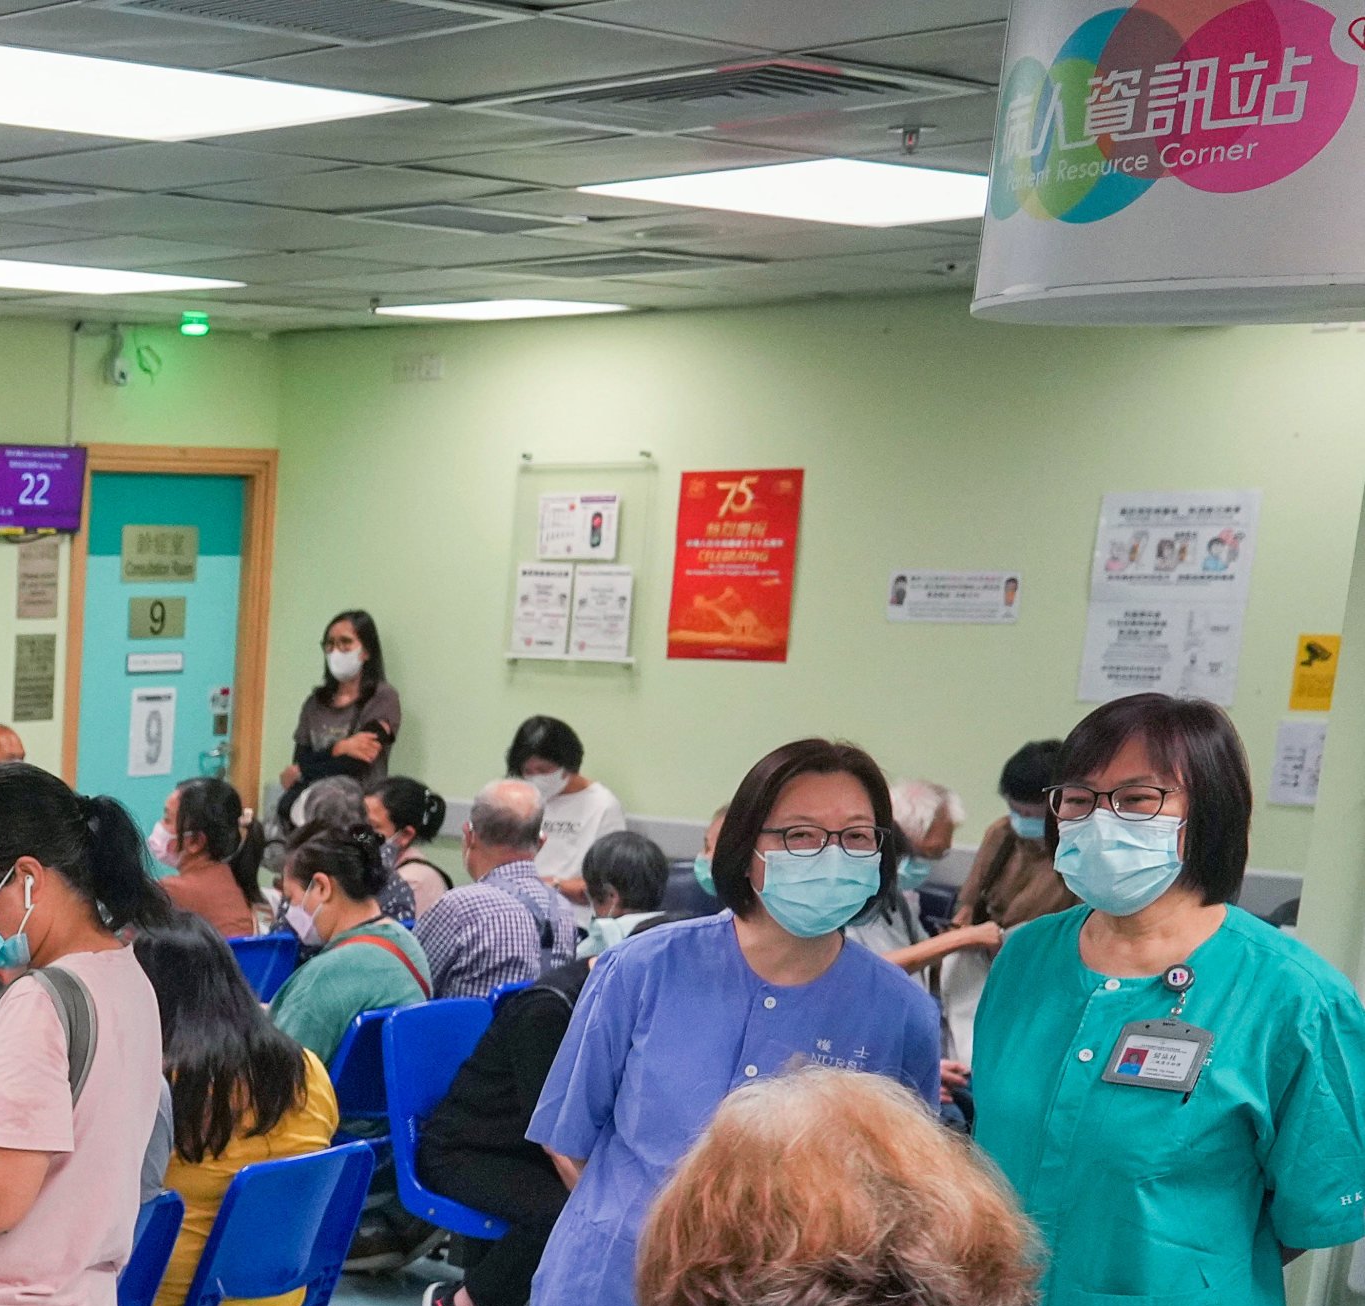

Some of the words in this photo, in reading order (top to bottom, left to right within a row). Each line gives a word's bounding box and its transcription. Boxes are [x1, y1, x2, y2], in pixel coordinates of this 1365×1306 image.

[1056, 153, 1149, 182] Resource
[1159, 139, 1259, 170] Corner
[18, 472, 51, 506] 22
[716, 476, 760, 518] 75
[149, 600, 166, 636] 9
[145, 709, 163, 765] 9
